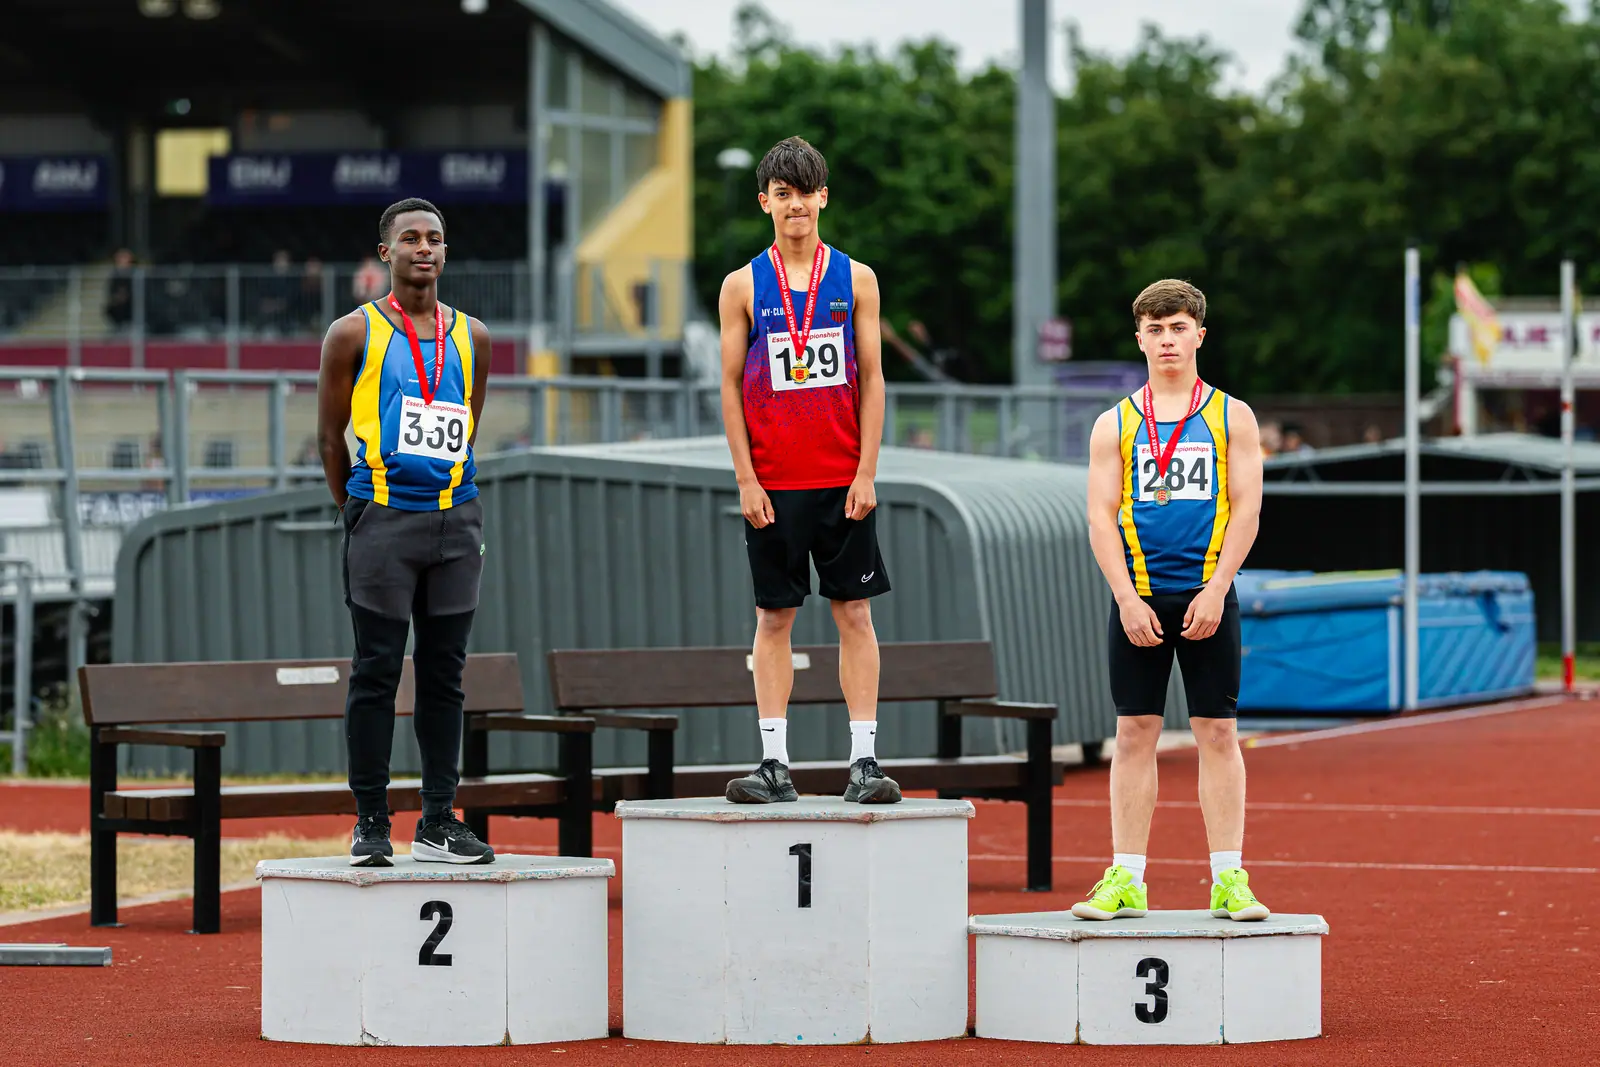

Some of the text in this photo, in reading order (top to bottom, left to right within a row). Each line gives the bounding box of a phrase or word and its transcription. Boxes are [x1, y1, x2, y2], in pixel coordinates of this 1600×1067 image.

[783, 291, 793, 314] COUNTY
[806, 292, 815, 316] COUNTY
[771, 335, 790, 344] Essex
[776, 343, 839, 382] 129
[405, 400, 423, 408] Essex
[1147, 417, 1156, 438] COUNTY
[1143, 456, 1208, 493] 284
[788, 843, 812, 909] 1
[418, 900, 454, 967] 2
[1134, 957, 1169, 1024] 3
